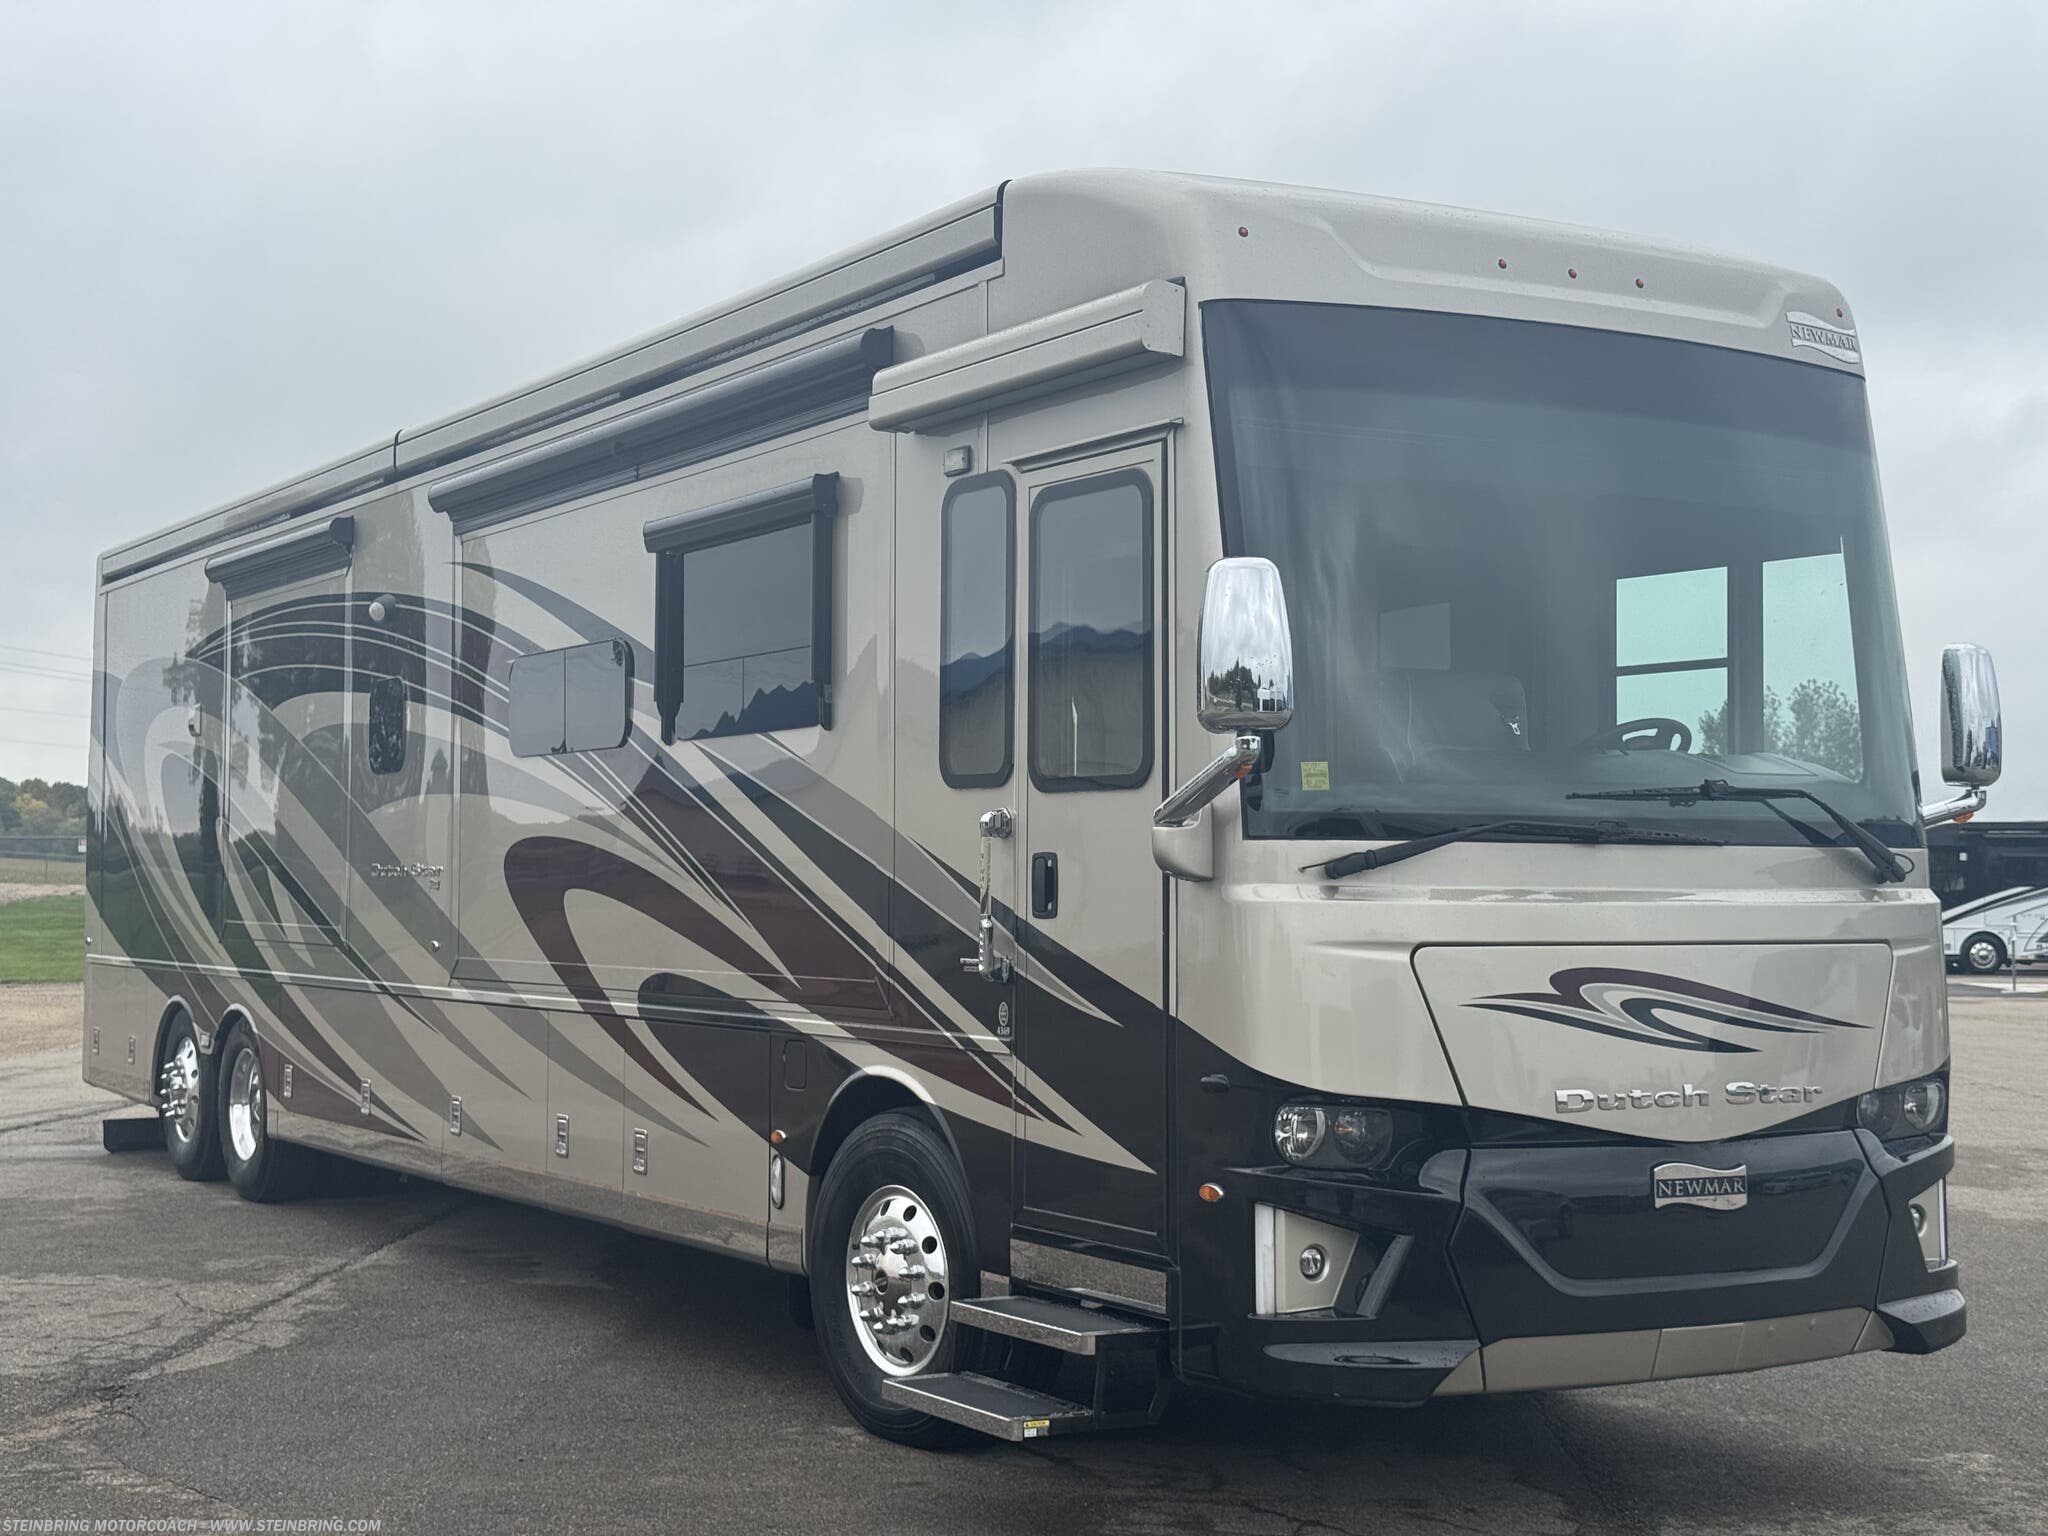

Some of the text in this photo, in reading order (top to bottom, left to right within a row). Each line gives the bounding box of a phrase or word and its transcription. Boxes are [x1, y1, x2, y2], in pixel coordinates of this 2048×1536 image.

[1790, 325, 1856, 351] NEWMAR
[1554, 1081, 1823, 1113] Dutch Star
[1658, 1178, 1745, 1196] NEWMAR
